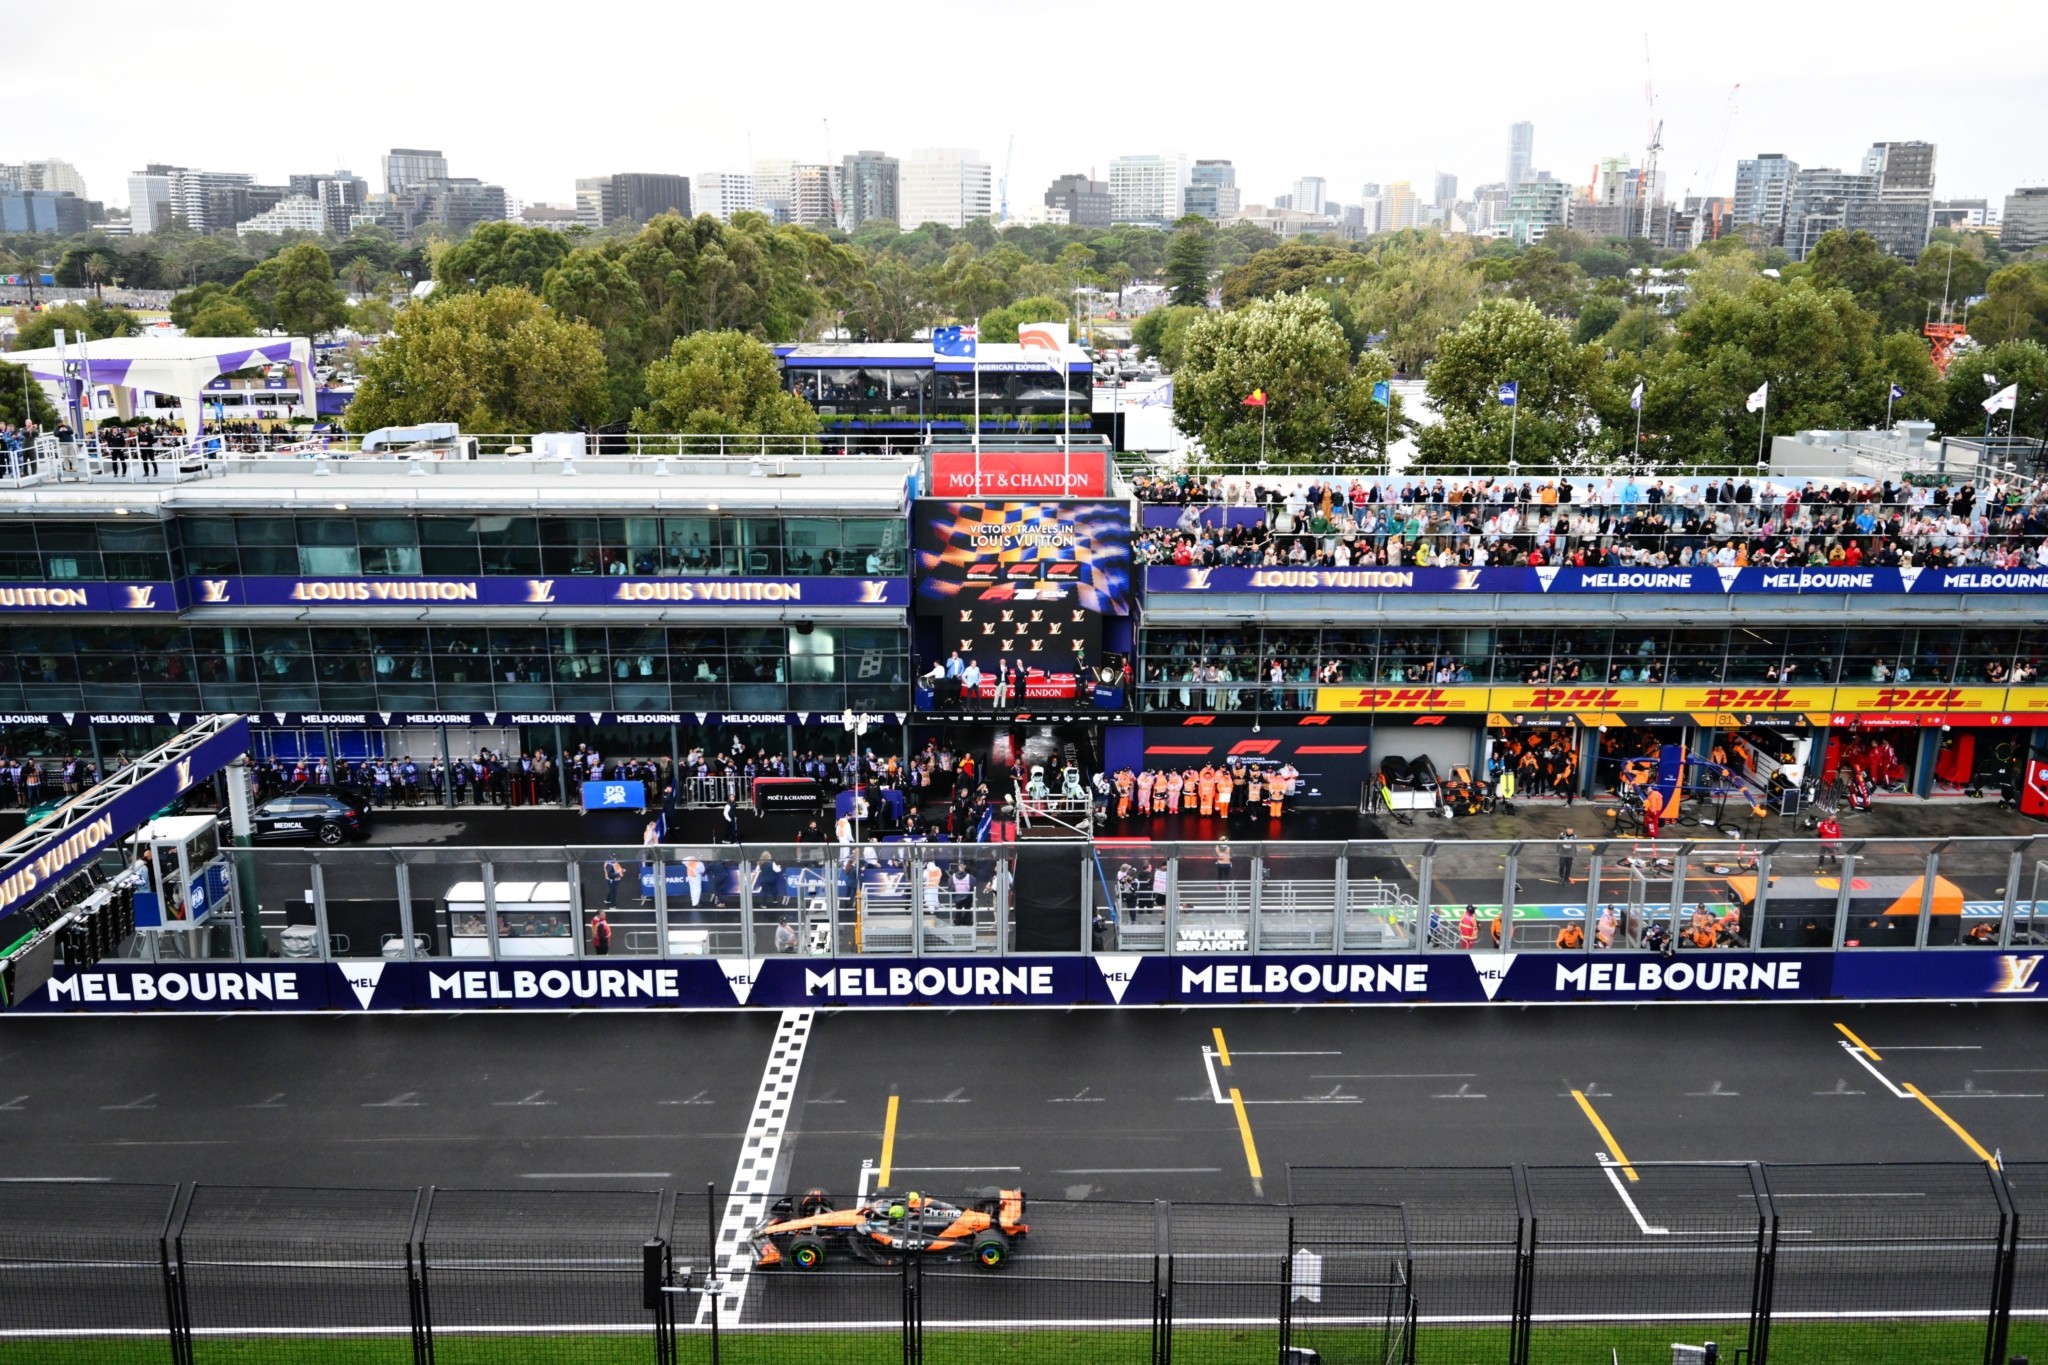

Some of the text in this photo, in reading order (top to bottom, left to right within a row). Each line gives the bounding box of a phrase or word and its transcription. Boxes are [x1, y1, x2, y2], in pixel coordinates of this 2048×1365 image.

[998, 474, 1008, 486] &
[1010, 473, 1088, 487] CHANDON
[970, 525, 1073, 533] VICTORY TRAVELS IN
[971, 536, 1073, 547] LOUIS VUITTON
[1252, 571, 1413, 588] LOUIS VUITTON
[1581, 573, 1692, 588] MELBOURNE
[1762, 573, 1874, 588] MELBOURNE
[293, 582, 477, 600] LOUIS VUITTON
[617, 582, 801, 600] LOUIS VUITTON
[1025, 689, 1062, 697] HANDON
[1357, 689, 1449, 707] DHL
[1529, 689, 1622, 707] DHL
[1701, 689, 1794, 707] DHL
[1874, 689, 1966, 707] DHL
[90, 715, 155, 723] MELBOURNE
[302, 715, 365, 723] MELBOURNE
[407, 715, 471, 723] MELBOURNE
[512, 715, 576, 723] MELBOURNE
[617, 715, 680, 723] MELBOURNE
[722, 715, 785, 723] MELBOURNE
[1719, 715, 1732, 725] 81
[1833, 716, 1845, 724] 44
[37, 812, 113, 880] VUITTON
[1180, 929, 1245, 940] WALKER
[1176, 940, 1248, 951] STRAIGHT
[727, 975, 755, 985] MEL
[1104, 972, 1131, 982] MEL
[1181, 963, 1428, 993] MELBOURNE
[1478, 970, 1503, 979] MEL
[1555, 962, 1802, 991] MELBOURNE
[349, 978, 377, 988] MEL
[429, 969, 679, 999] MELBOURNE
[805, 966, 1053, 996] MELBOURNE
[47, 972, 299, 1002] MELBOURNE
[924, 1208, 962, 1217] Chrome
